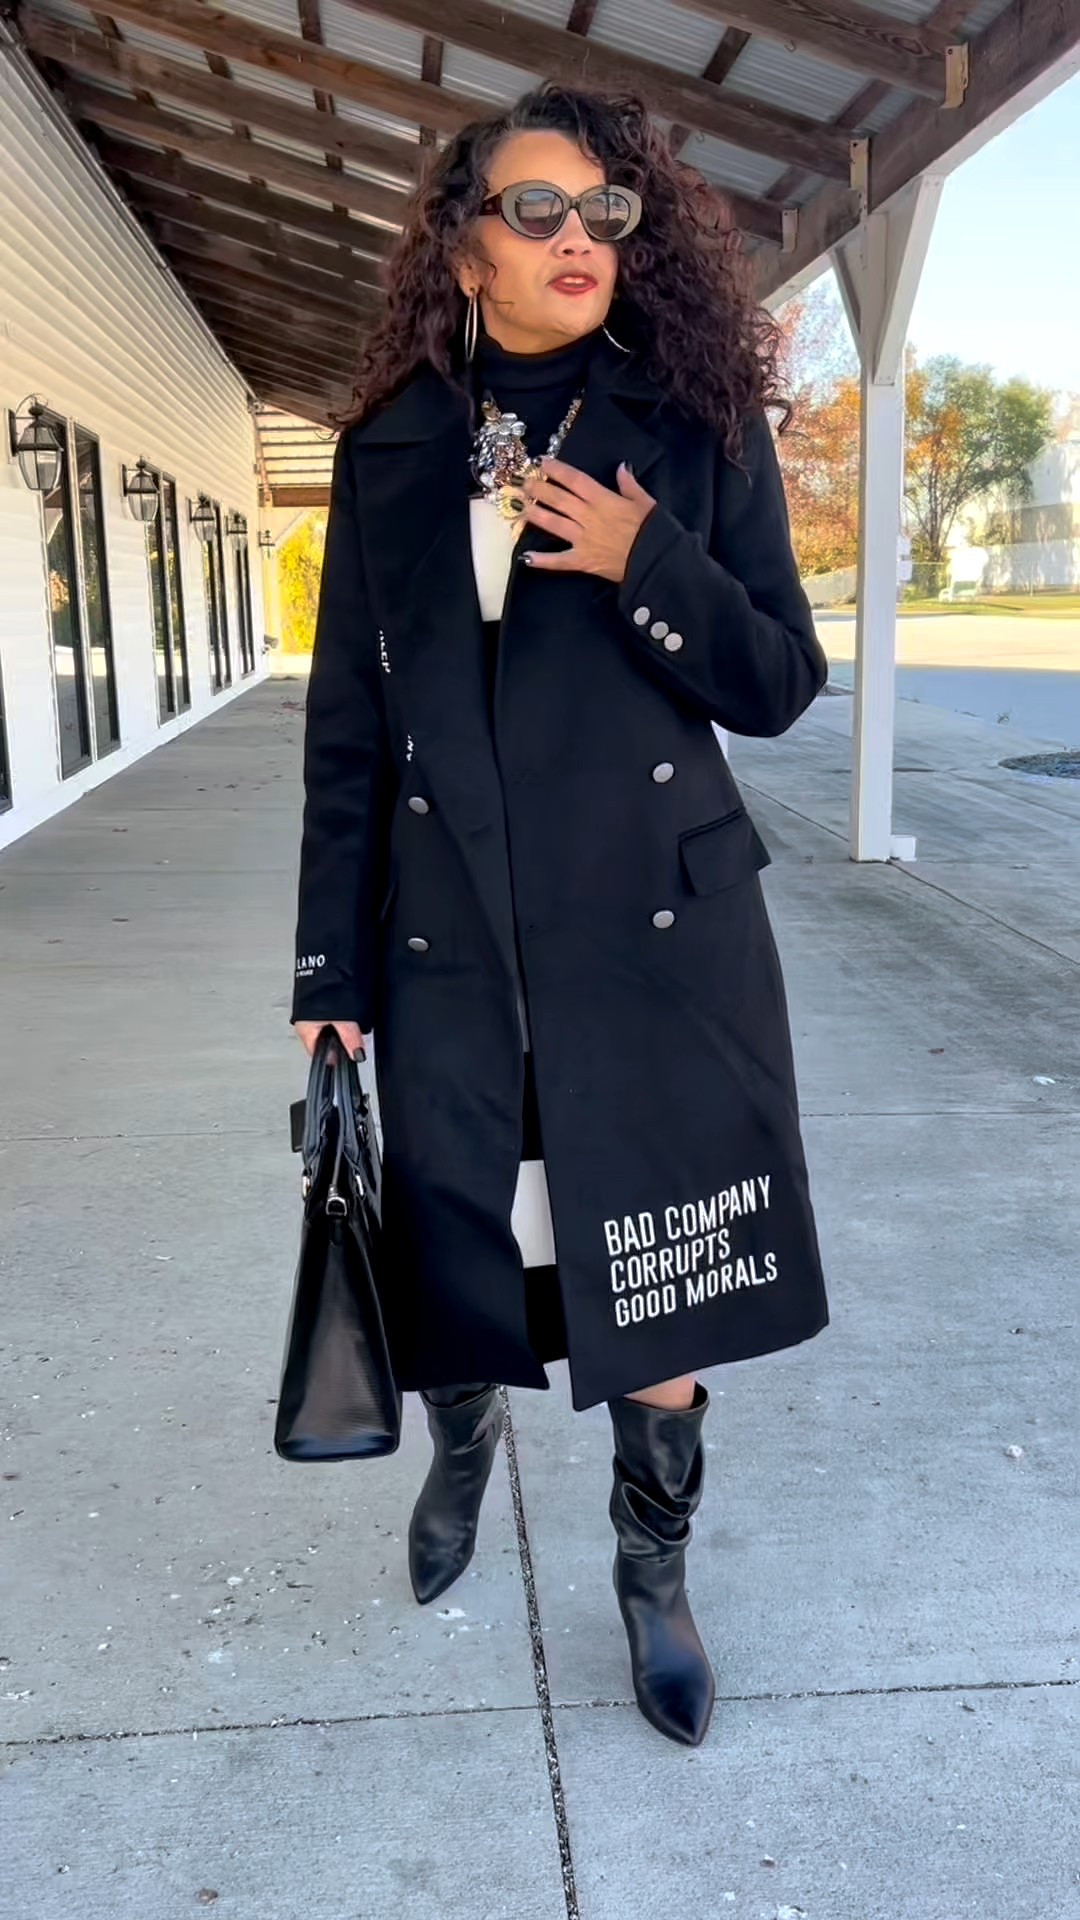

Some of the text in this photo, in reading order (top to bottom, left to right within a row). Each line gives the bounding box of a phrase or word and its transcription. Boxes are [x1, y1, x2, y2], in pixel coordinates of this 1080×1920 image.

[604, 1175, 770, 1256] BAD COMPANY
[610, 1228, 731, 1293] CORRUPTS
[615, 1252, 778, 1327] GOOD MORALS
